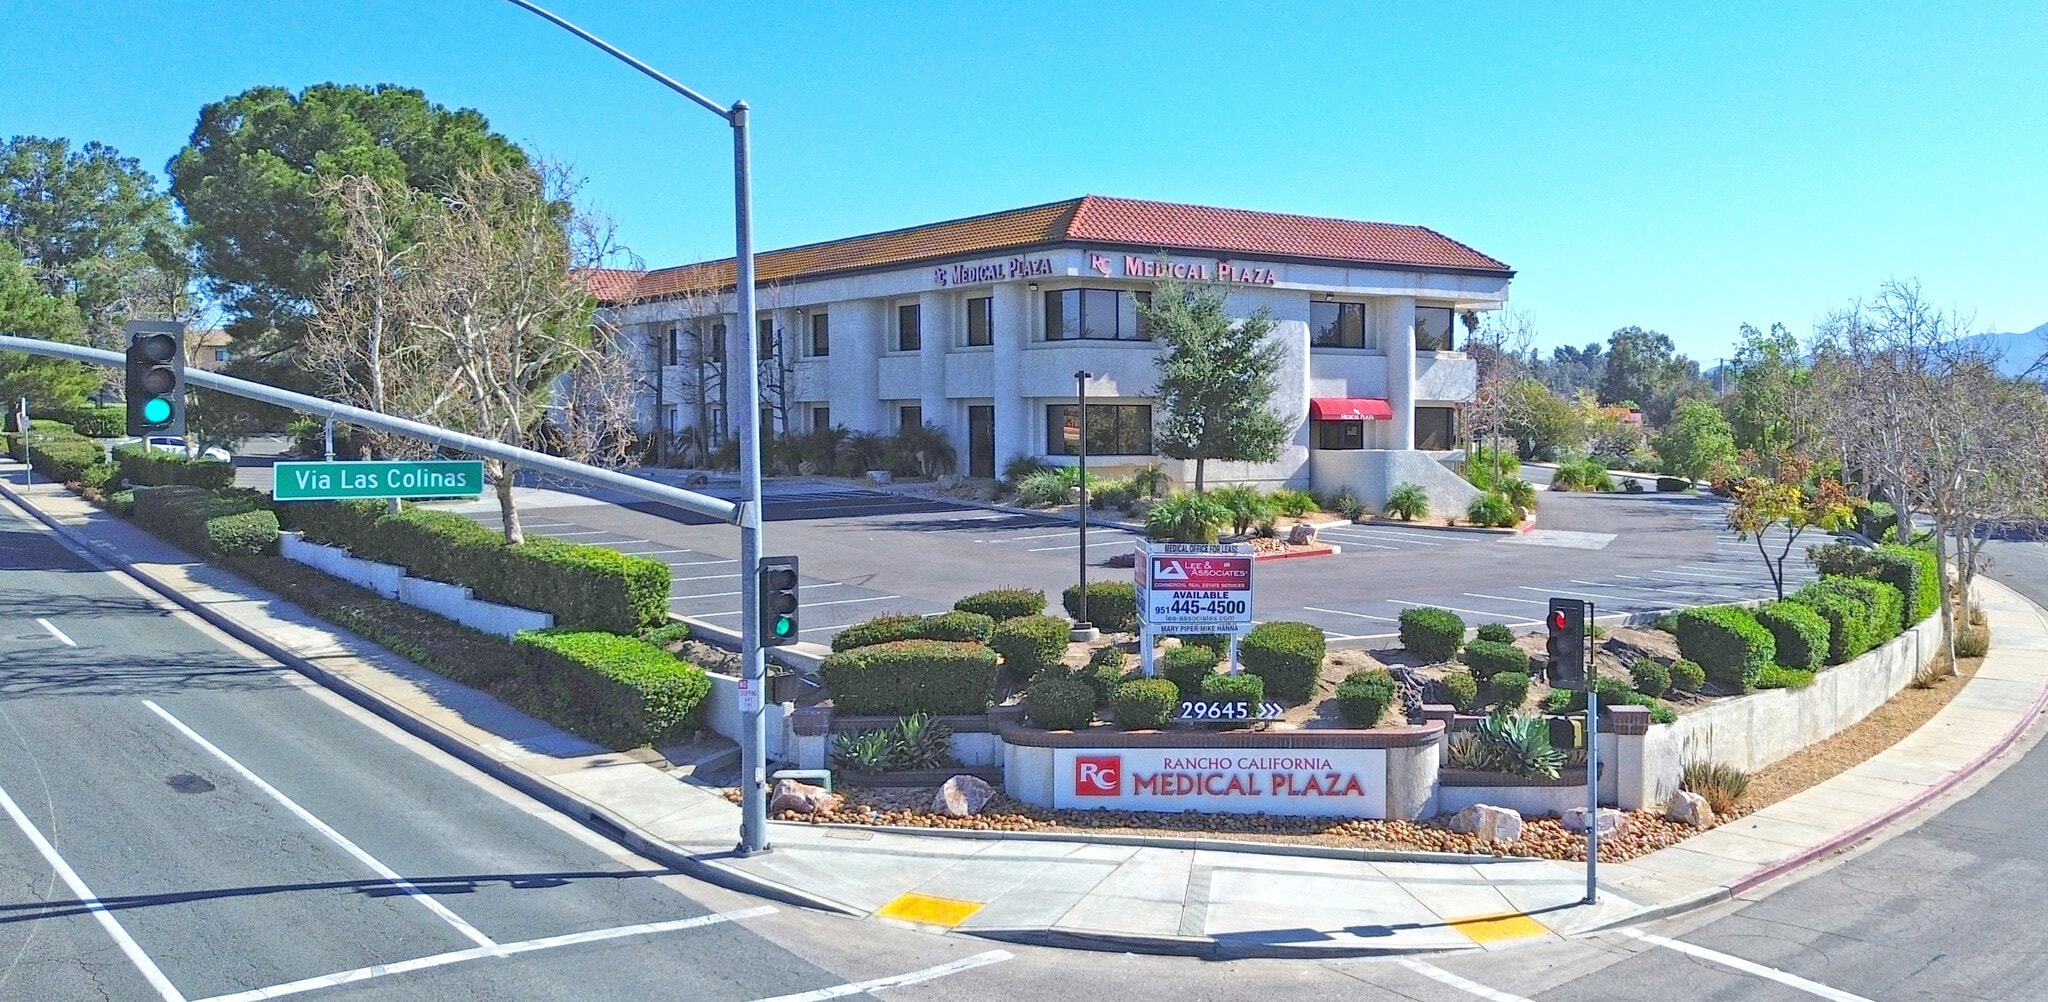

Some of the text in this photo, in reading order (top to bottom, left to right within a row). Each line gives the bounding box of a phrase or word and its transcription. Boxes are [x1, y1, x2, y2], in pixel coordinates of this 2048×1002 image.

[952, 265, 1005, 284] MEDICAL
[1010, 258, 1053, 278] PLAZA
[1088, 253, 1277, 284] RC MEDICAL PLAZA
[295, 468, 467, 490] Via Las Colinas
[1164, 544, 1239, 554] MEDICAL OFFICE FOR LEASE
[1184, 561, 1212, 569] LEE &
[1190, 569, 1246, 577] ASSOCIATES
[1172, 591, 1230, 599] AVAILABLE
[1155, 600, 1246, 614] 951 445-4500
[1181, 702, 1248, 719] 29645
[1164, 757, 1332, 770] RANCHO CALIFORNIA
[1080, 763, 1117, 790] RC
[1132, 773, 1365, 797] MEDICAL PLAZA
